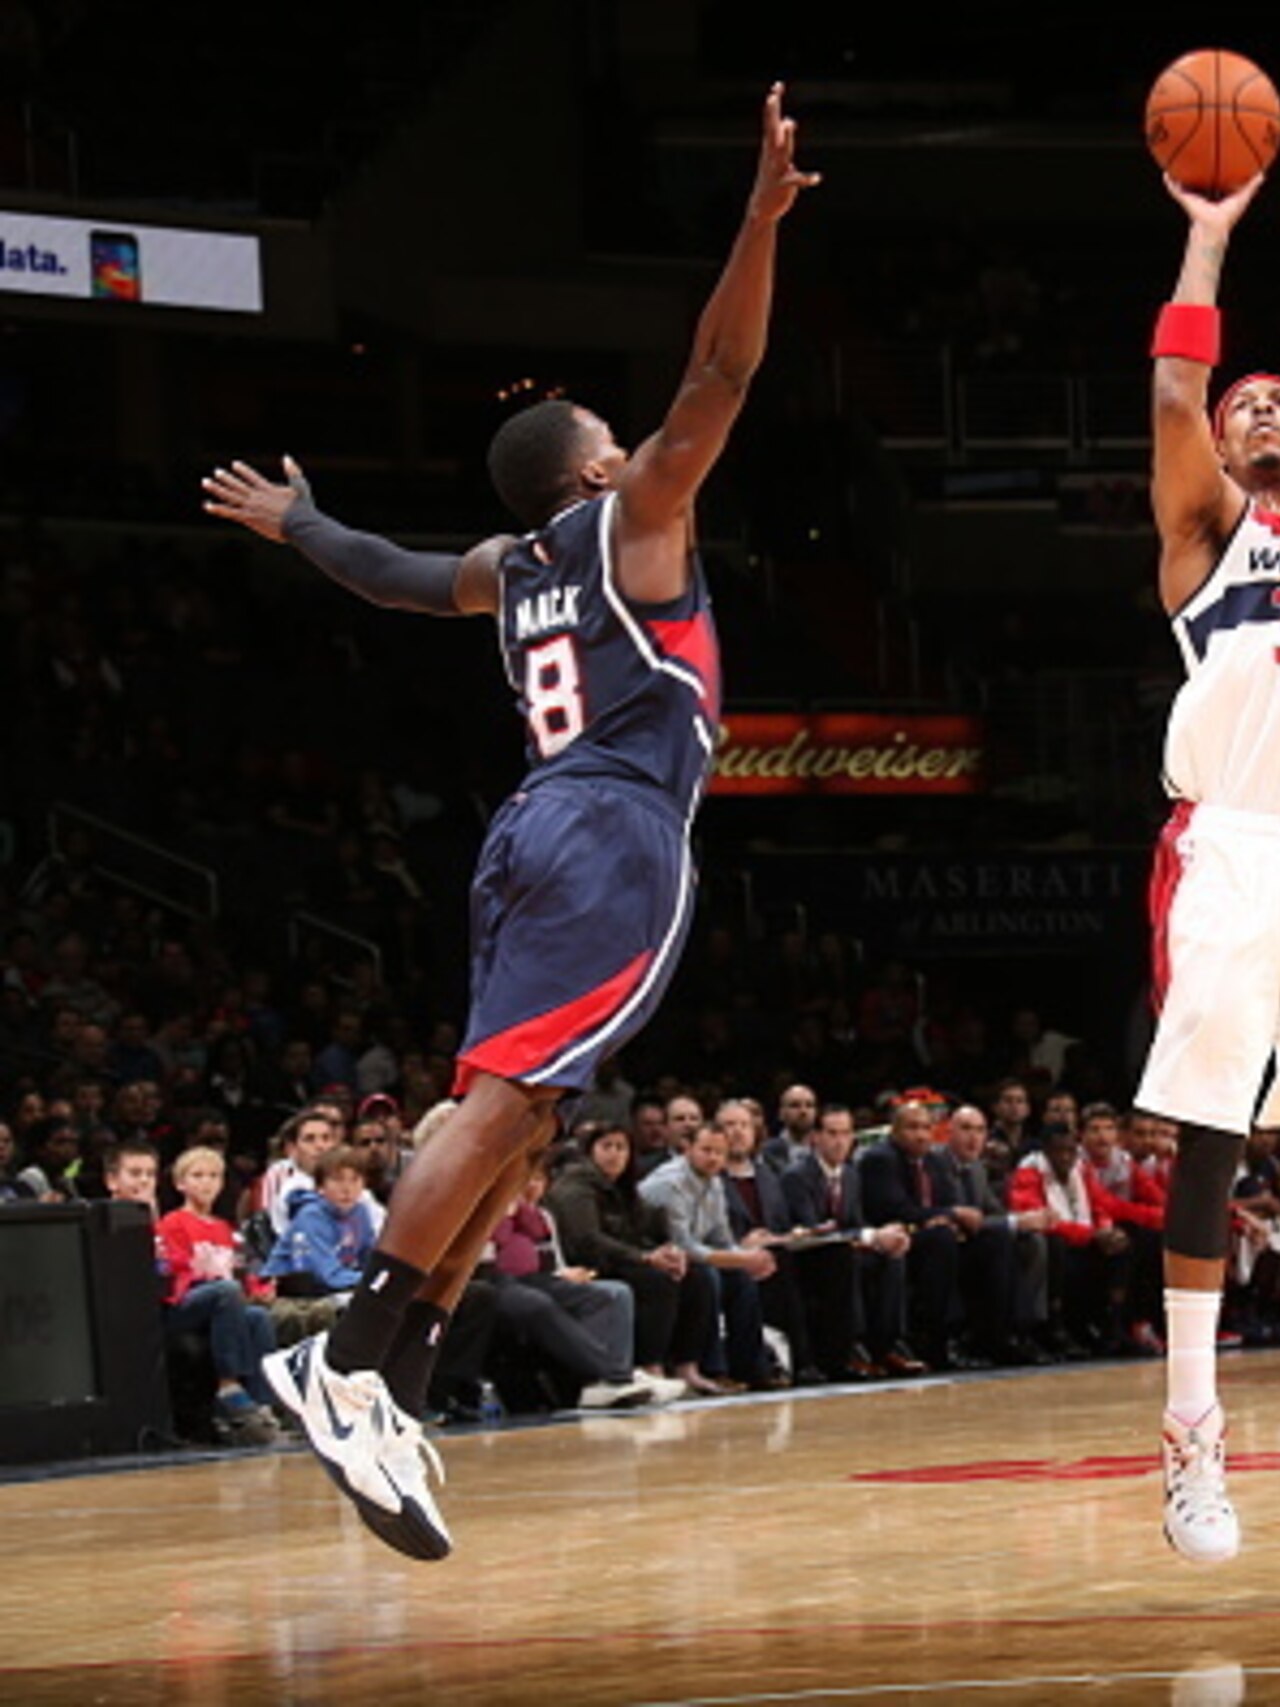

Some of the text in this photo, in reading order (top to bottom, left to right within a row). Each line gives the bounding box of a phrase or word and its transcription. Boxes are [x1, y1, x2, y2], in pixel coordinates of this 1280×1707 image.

[516, 584, 583, 642] MACK
[523, 632, 587, 760] 8
[863, 864, 1121, 900] MASERATI
[931, 911, 1105, 937] ARLINGTON
